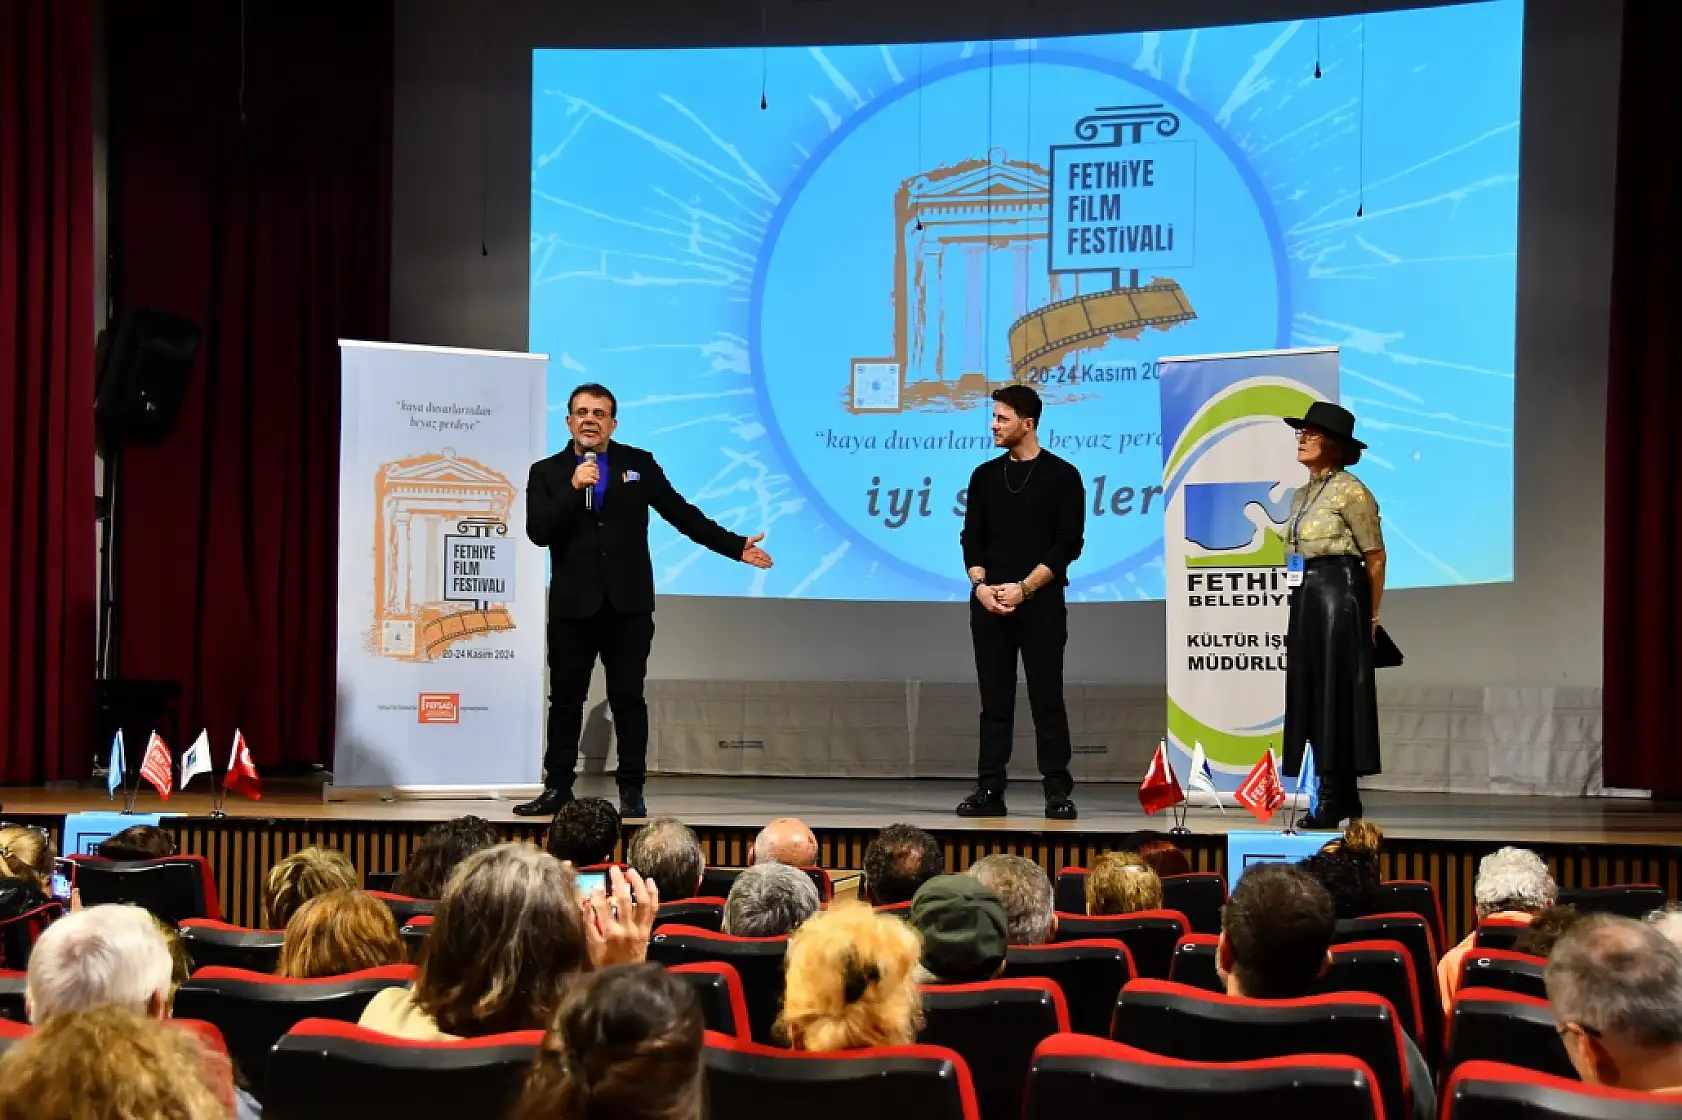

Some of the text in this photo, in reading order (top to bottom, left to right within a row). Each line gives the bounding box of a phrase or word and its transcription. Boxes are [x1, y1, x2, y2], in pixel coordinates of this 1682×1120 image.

[1029, 364, 1077, 384] 20-24
[1082, 363, 1137, 383] Kasım
[1048, 428, 1113, 454] beyaz
[865, 476, 932, 529] iyi
[1186, 631, 1260, 648] KÜLTÜR
[442, 648, 465, 659] 20-24
[494, 649, 515, 659] 2024
